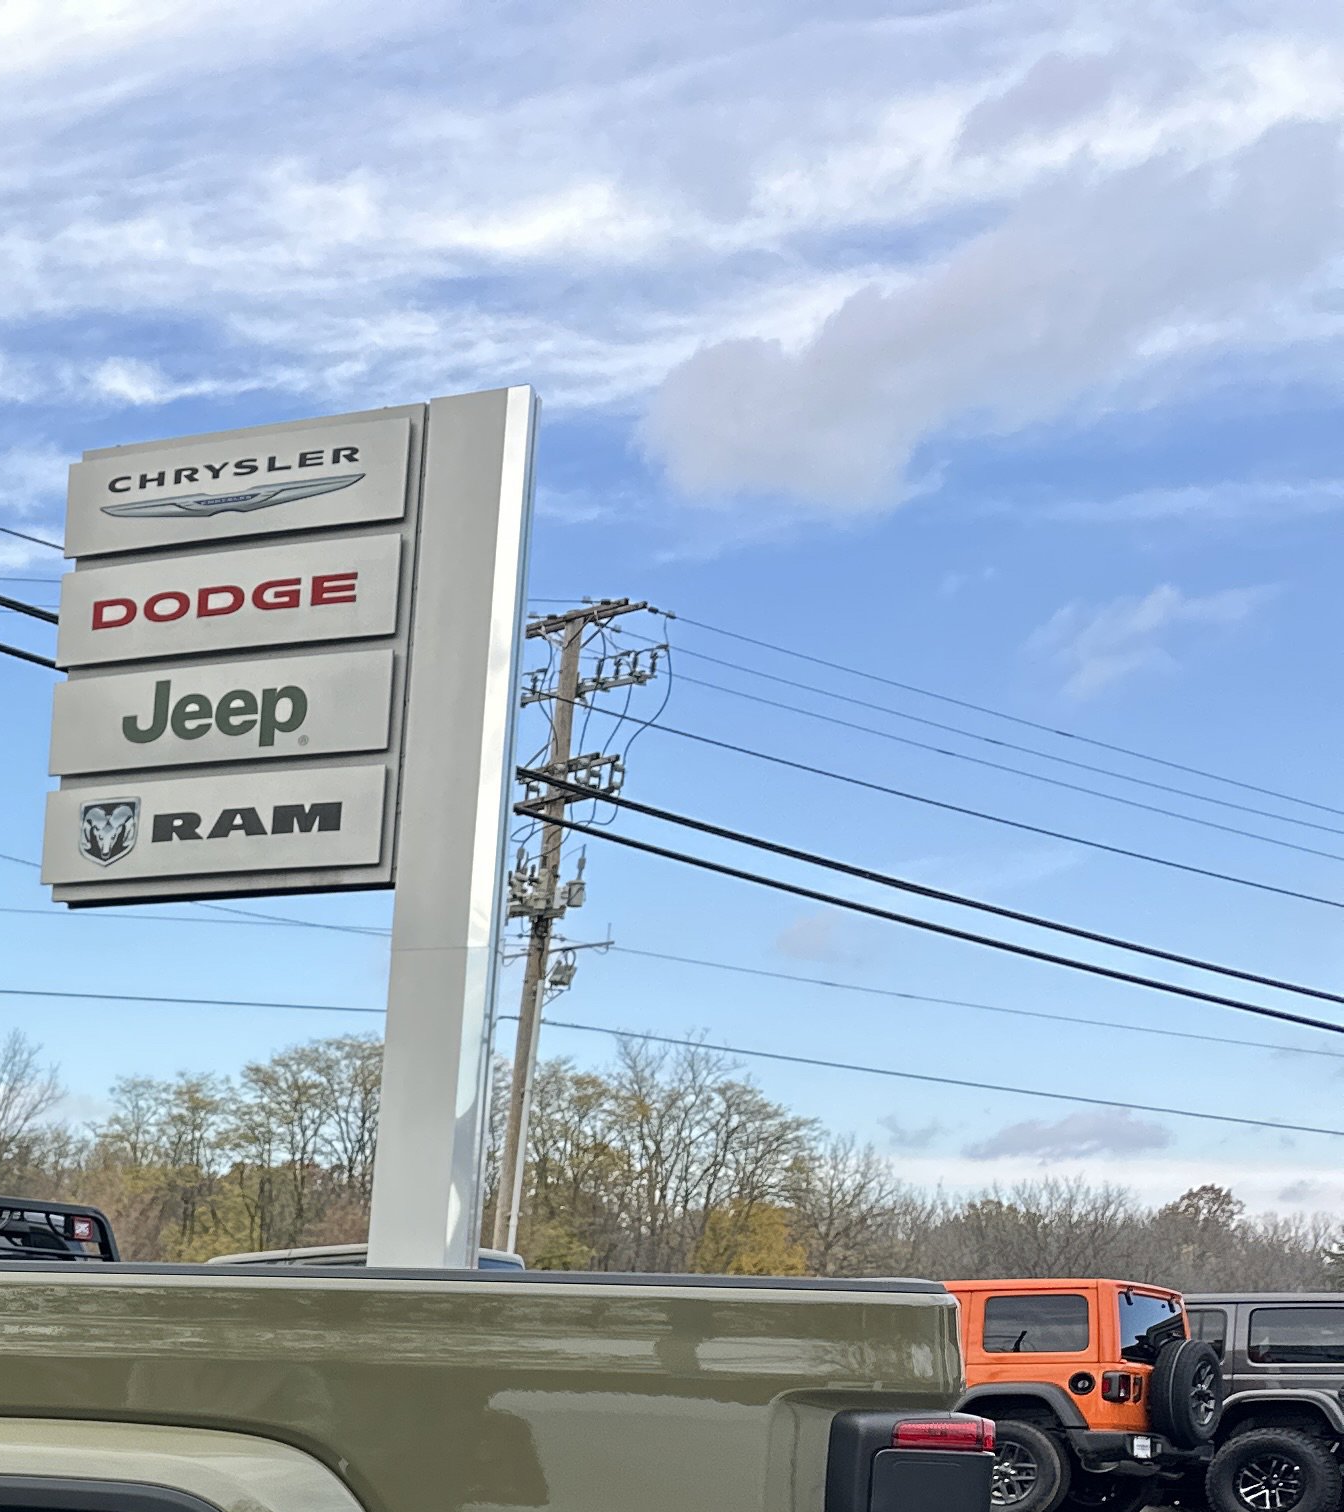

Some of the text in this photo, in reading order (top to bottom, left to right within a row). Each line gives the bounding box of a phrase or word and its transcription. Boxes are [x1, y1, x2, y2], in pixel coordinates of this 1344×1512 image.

[108, 446, 360, 493] CHRYSLER
[91, 572, 359, 631] DODGE
[122, 680, 308, 747] Jeep
[151, 802, 343, 843] RAM
